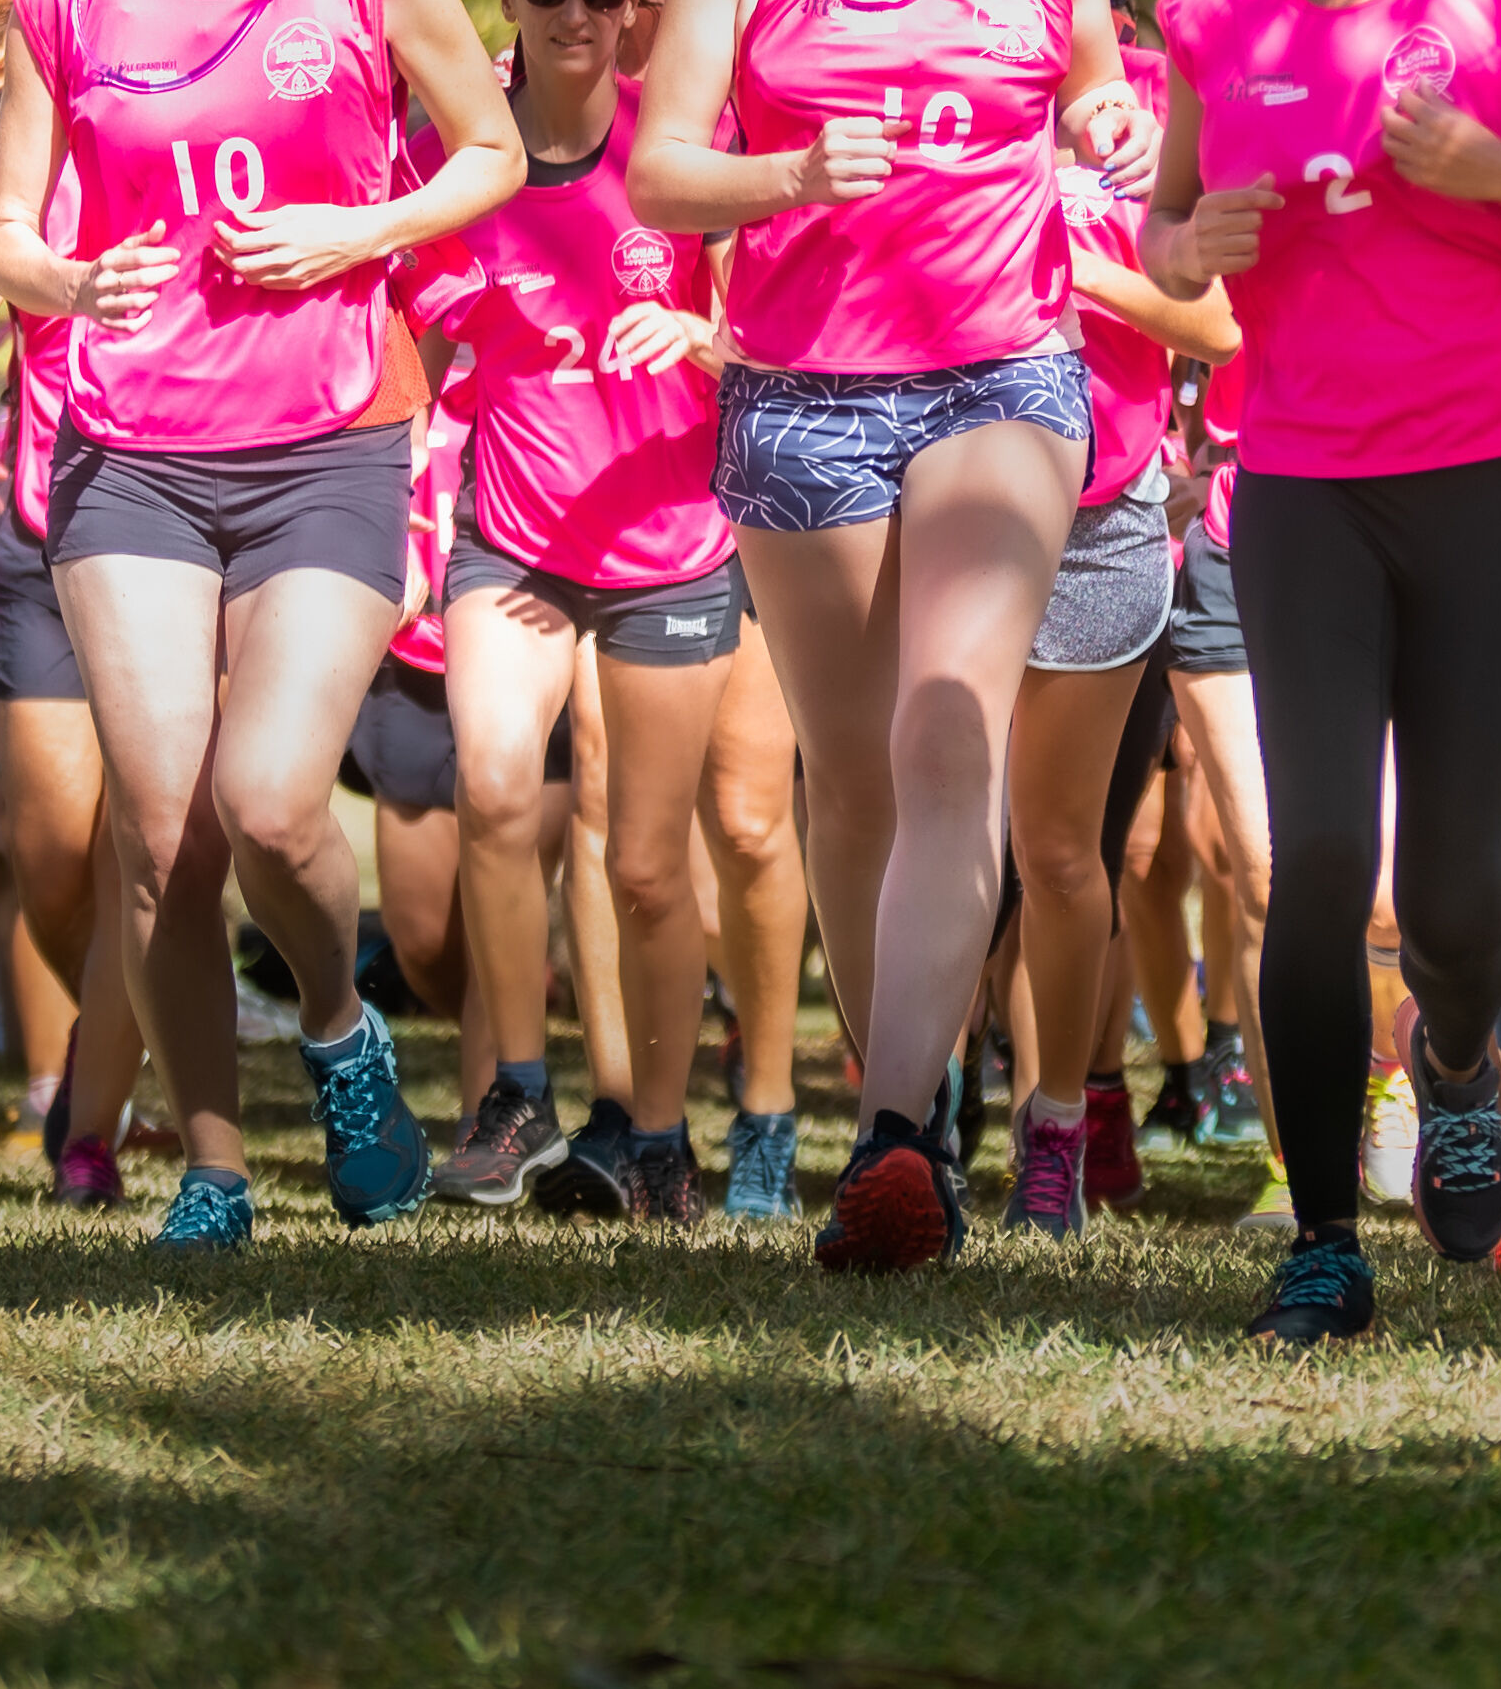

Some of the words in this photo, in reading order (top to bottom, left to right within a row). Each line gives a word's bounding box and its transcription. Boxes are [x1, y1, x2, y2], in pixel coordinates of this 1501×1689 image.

[883, 87, 973, 162] 10
[171, 137, 265, 215] 10
[1304, 153, 1373, 215] 2
[623, 246, 664, 259] LOKAL
[544, 325, 636, 385] 24
